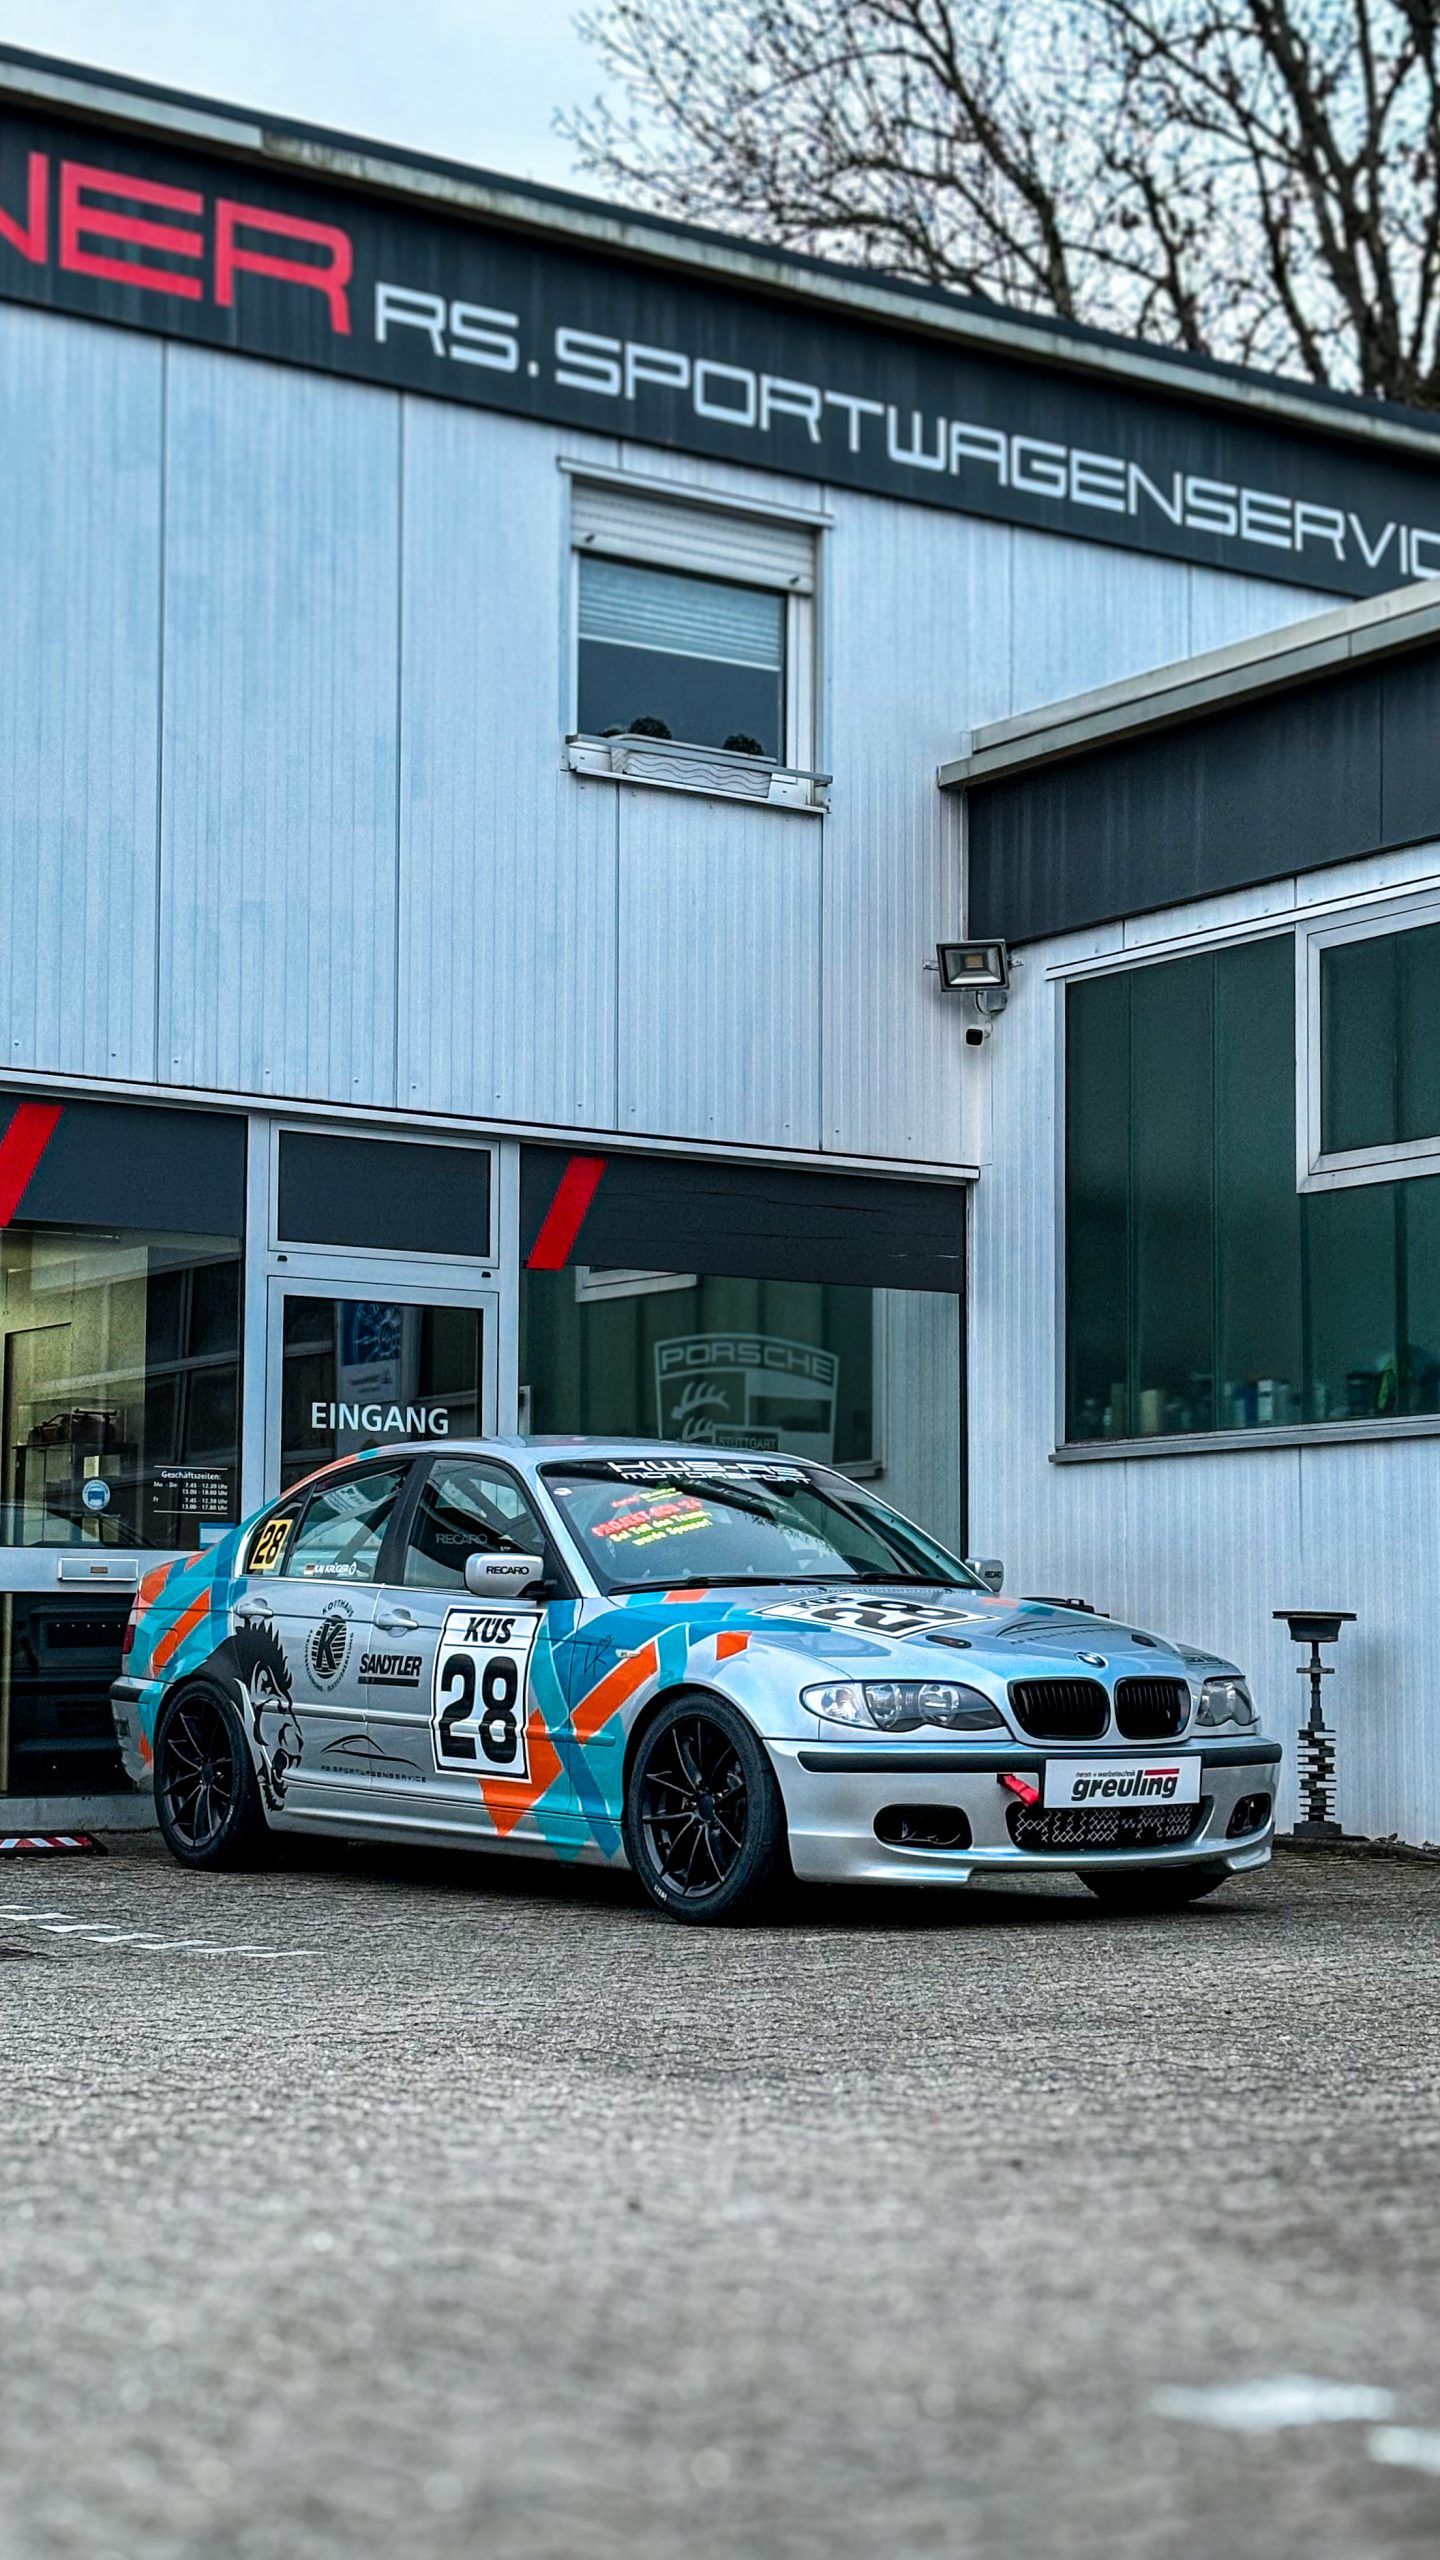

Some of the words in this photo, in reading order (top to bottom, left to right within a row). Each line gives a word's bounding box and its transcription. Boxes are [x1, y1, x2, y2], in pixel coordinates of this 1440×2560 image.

[661, 1342, 832, 1382] PORSCHE
[311, 1402, 449, 1435] EINGANG
[717, 1436, 777, 1449] STUTTGART
[161, 1470, 222, 1480] Geschäftszeiten:
[620, 1472, 811, 1484] MOTORSPORT
[253, 1523, 288, 1564] 28
[435, 1533, 488, 1545] RECARO
[485, 1565, 530, 1575] RECARO
[322, 1599, 355, 1618] KOTTHAUS
[811, 1600, 968, 1633] 28
[463, 1617, 516, 1644] KÜS
[359, 1653, 422, 1677] SANDTLER
[438, 1653, 518, 1764] 28
[1071, 1769, 1179, 1802] greuling
